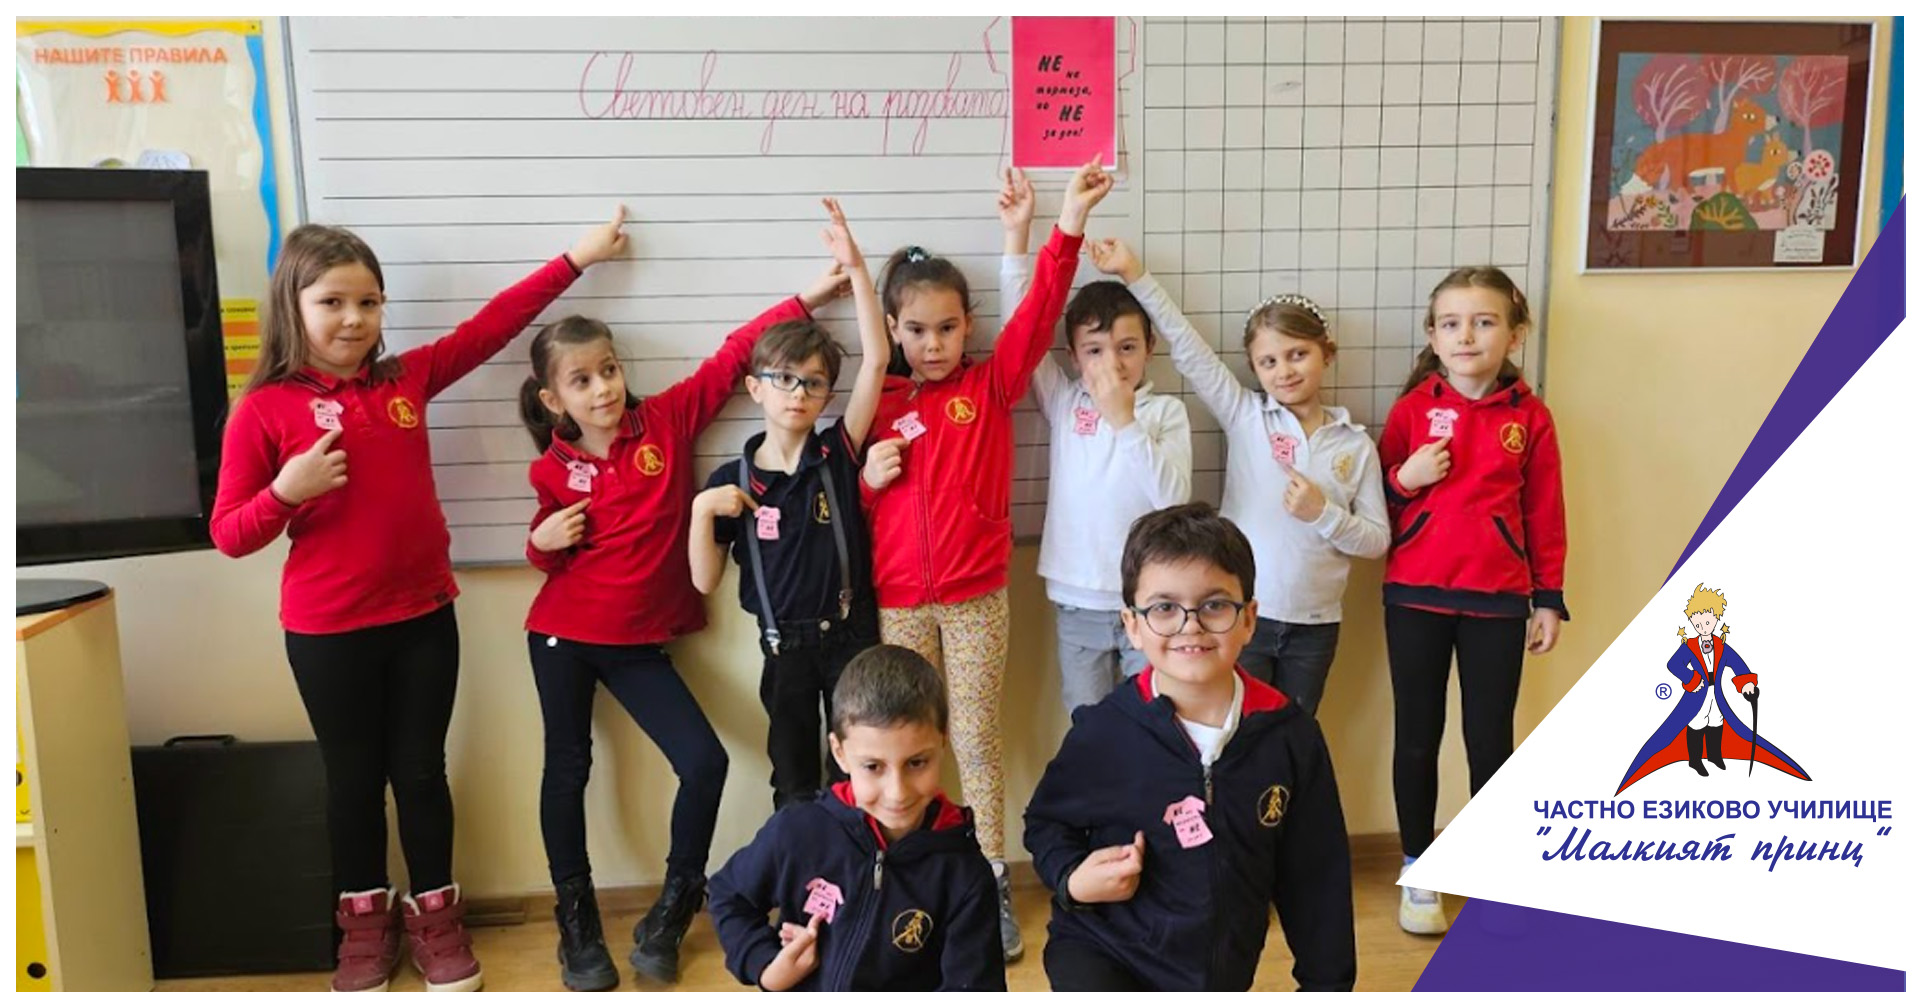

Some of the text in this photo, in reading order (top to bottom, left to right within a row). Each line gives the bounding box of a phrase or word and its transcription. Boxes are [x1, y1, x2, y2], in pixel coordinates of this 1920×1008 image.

[34, 47, 228, 64] НАШИТЕ ПРАВИЛА
[1038, 55, 1063, 72] НЕ
[580, 50, 752, 119] Световен
[760, 90, 824, 155] ден
[830, 91, 870, 119] на
[1059, 105, 1084, 121] НЕ
